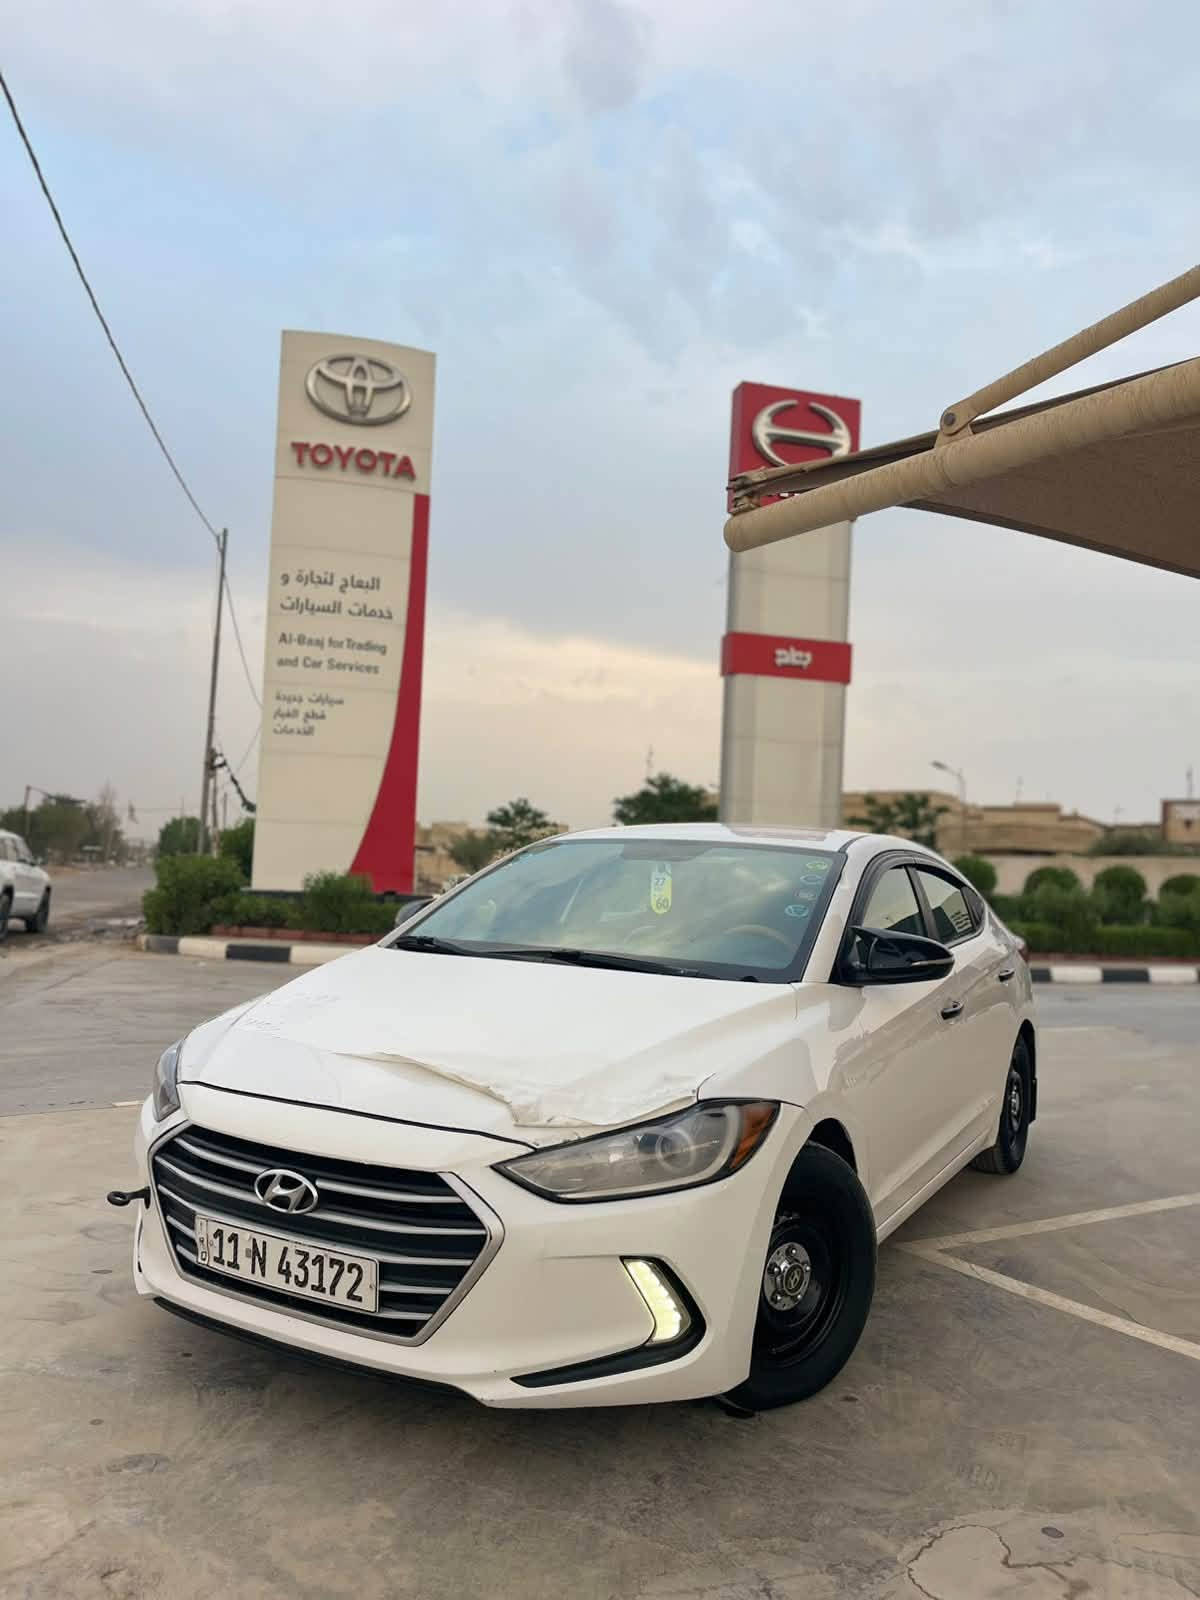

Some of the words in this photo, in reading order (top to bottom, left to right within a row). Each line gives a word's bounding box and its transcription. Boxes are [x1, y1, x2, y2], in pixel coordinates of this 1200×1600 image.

[290, 441, 417, 482] TOYOTA
[280, 573, 290, 586] و
[280, 596, 342, 615] السيارات
[347, 602, 393, 620] خدمات
[328, 636, 345, 649] for
[345, 637, 387, 656] Trading
[277, 656, 299, 668] and
[303, 656, 323, 669] Car
[327, 658, 380, 675] Services
[213, 1228, 240, 1271] 11
[251, 1237, 266, 1277] N
[277, 1246, 363, 1302] 43172
